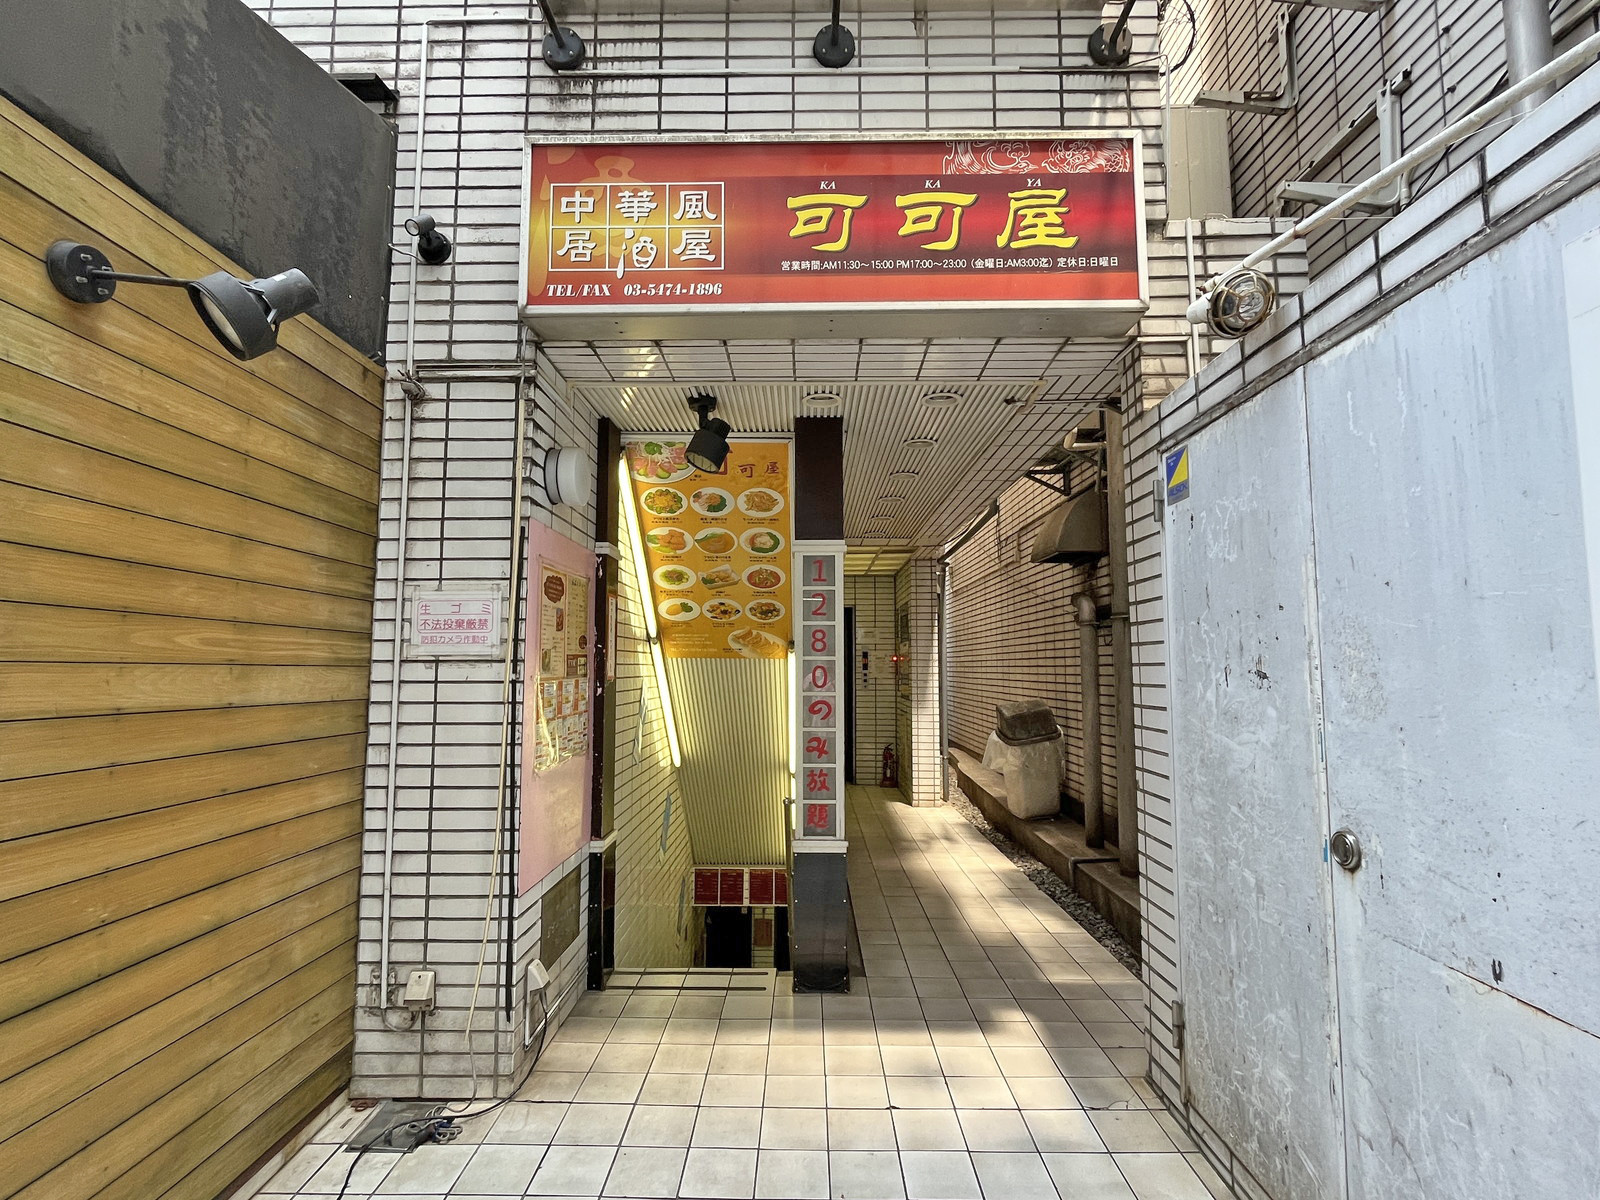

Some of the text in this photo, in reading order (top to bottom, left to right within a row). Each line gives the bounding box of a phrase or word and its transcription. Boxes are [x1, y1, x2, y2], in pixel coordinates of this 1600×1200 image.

[819, 177, 1042, 190] KA KA YA
[560, 190, 717, 223] 中華風
[787, 187, 1079, 252] 可可屋
[557, 229, 716, 279] 居酒屋
[546, 283, 723, 297] TEL/FAX 03-5474-1896
[420, 603, 491, 615] 生ゴミ
